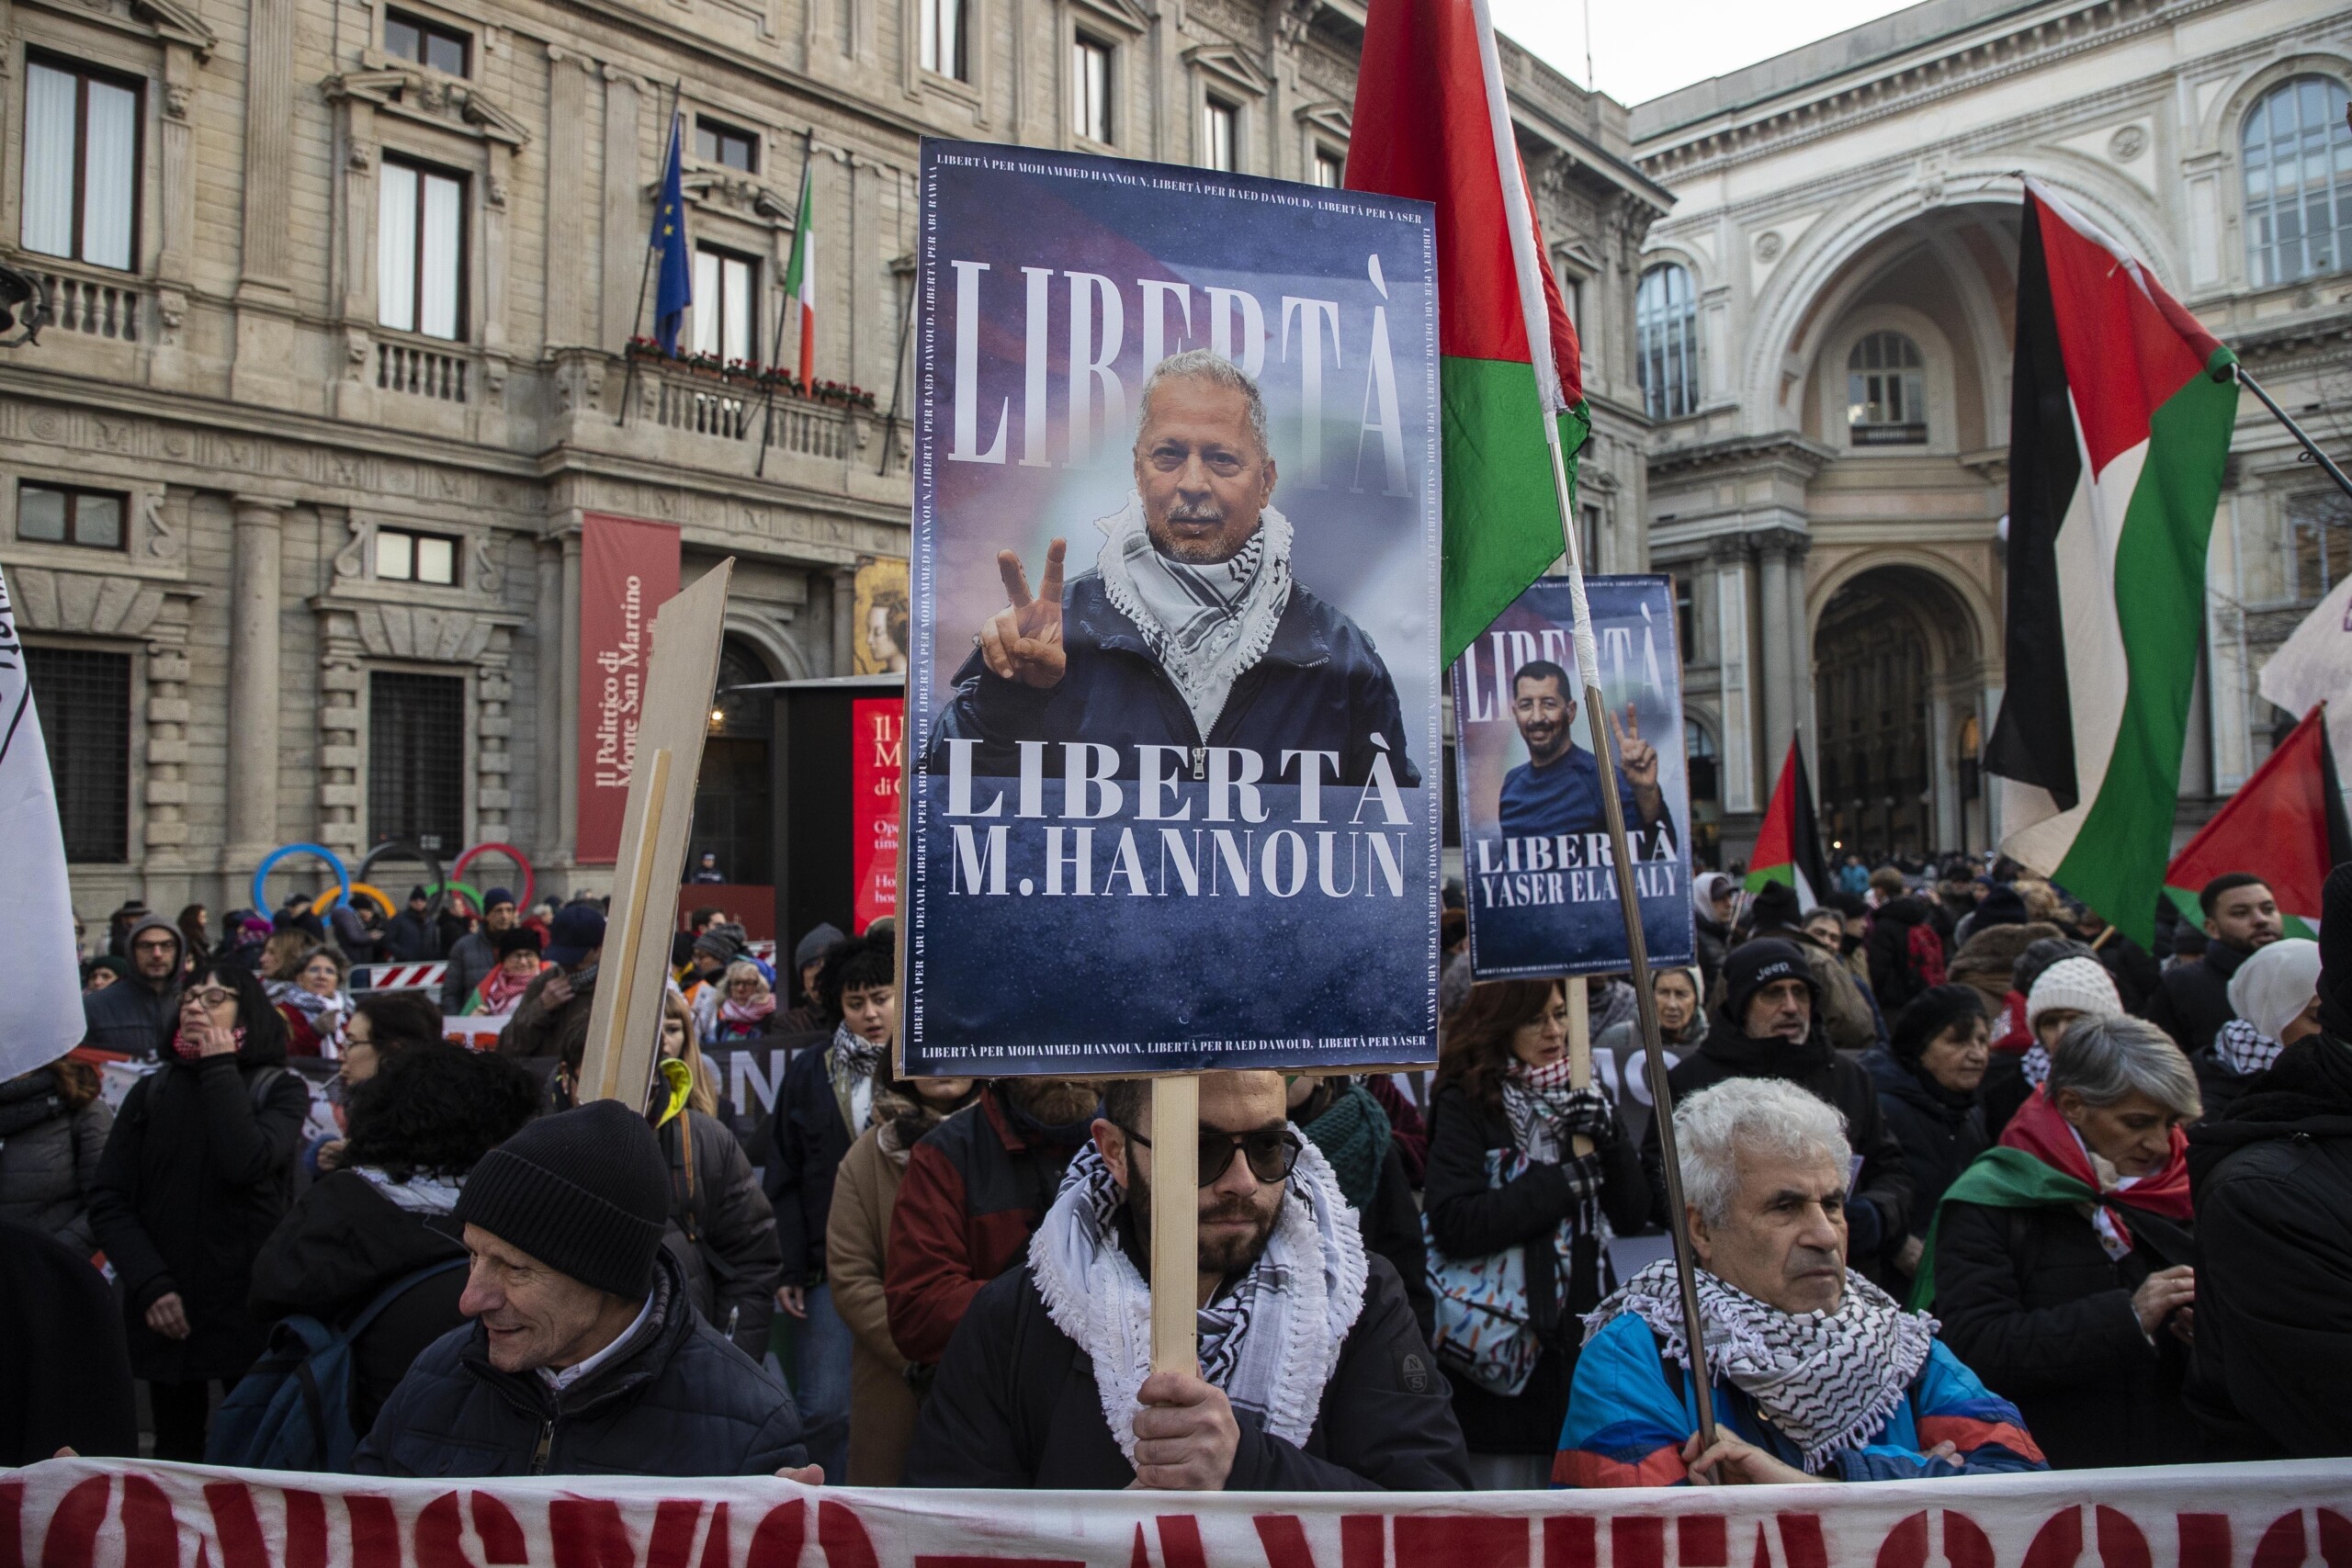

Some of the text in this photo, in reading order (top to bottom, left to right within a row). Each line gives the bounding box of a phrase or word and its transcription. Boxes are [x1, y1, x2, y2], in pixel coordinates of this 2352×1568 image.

[937, 154, 1422, 224] LIBERTÀ PER MOHAMMED HANNOUN, LIBERTÀ PER RAED DAWOUD, LIBERTÀ PER YASER
[1423, 228, 1433, 273] LIBERTÀ
[1425, 276, 1433, 296] PER
[1425, 300, 1433, 318] ABU
[1425, 323, 1433, 360] DEIAH,
[1426, 363, 1436, 410] LIBERTÀ
[1427, 412, 1435, 434] PER
[1427, 437, 1435, 464] ABDU
[1428, 468, 1436, 505] SALEH
[1428, 510, 1437, 558] LIBERTÀ
[619, 575, 640, 668] Martino
[913, 166, 937, 1043] LIBERTÀ PER ABU DEIAH, LIBERTÀ PER ABDU SALEH LIBERTÀ PER MOHAMMED HANNOUN, LIBERTÀ PER RAED DAWOUD, LIBERTÀ PER ABU RAWAA
[617, 672, 639, 714] San
[595, 650, 619, 787] Il Polittico di
[1429, 716, 1439, 764] LIBERTÀ
[943, 732, 1413, 825] LIBERTÀ
[1429, 768, 1437, 789] PER
[1429, 793, 1437, 824] RAED
[948, 825, 1407, 897] M.HANNOUN
[1429, 827, 1437, 882] DAWOUD,
[1476, 819, 1679, 874] LIBERTÀ
[1481, 864, 1678, 908] YASER ELAALY
[1429, 886, 1438, 933] LIBERTÀ
[1428, 938, 1436, 959] PER
[1428, 964, 1436, 986] ABU
[1757, 962, 1790, 981] Jeep
[1427, 988, 1436, 1031] RAWAA
[922, 1034, 1426, 1058] LIBERTÀ PER MOHAMMED HANNOUN, LIBERTÀ PER RAED DAWOUD, LIBERTÀ PER YASER
